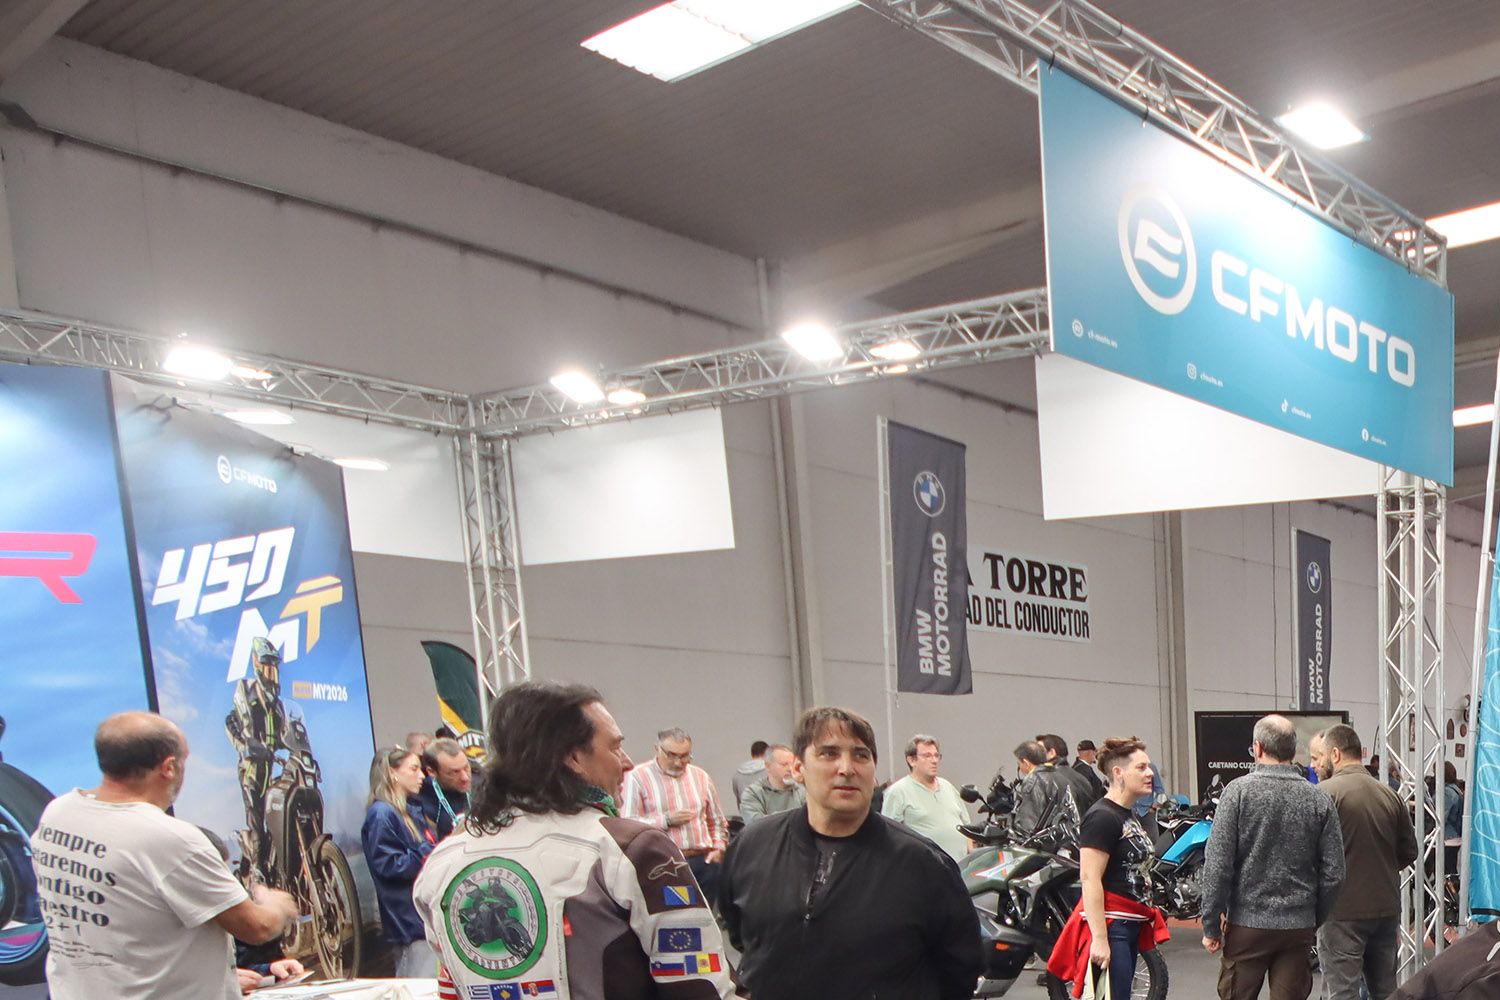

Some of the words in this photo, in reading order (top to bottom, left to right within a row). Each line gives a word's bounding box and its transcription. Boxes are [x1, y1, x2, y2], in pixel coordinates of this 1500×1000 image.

[1210, 250, 1415, 388] CFMOTO
[232, 466, 278, 493] CFMOTO
[152, 526, 296, 620] 450
[983, 552, 1089, 603] TORRE
[931, 532, 952, 677] MOTORRAD
[986, 598, 1012, 630] DEL
[1015, 600, 1090, 639] CONDUCTOR
[916, 609, 935, 675] BMW
[1316, 603, 1325, 704] MOTORRAD
[313, 683, 348, 701] MY2026
[1208, 761, 1238, 770] CAETANO
[38, 822, 107, 859] iempre
[40, 896, 110, 927] aestro
